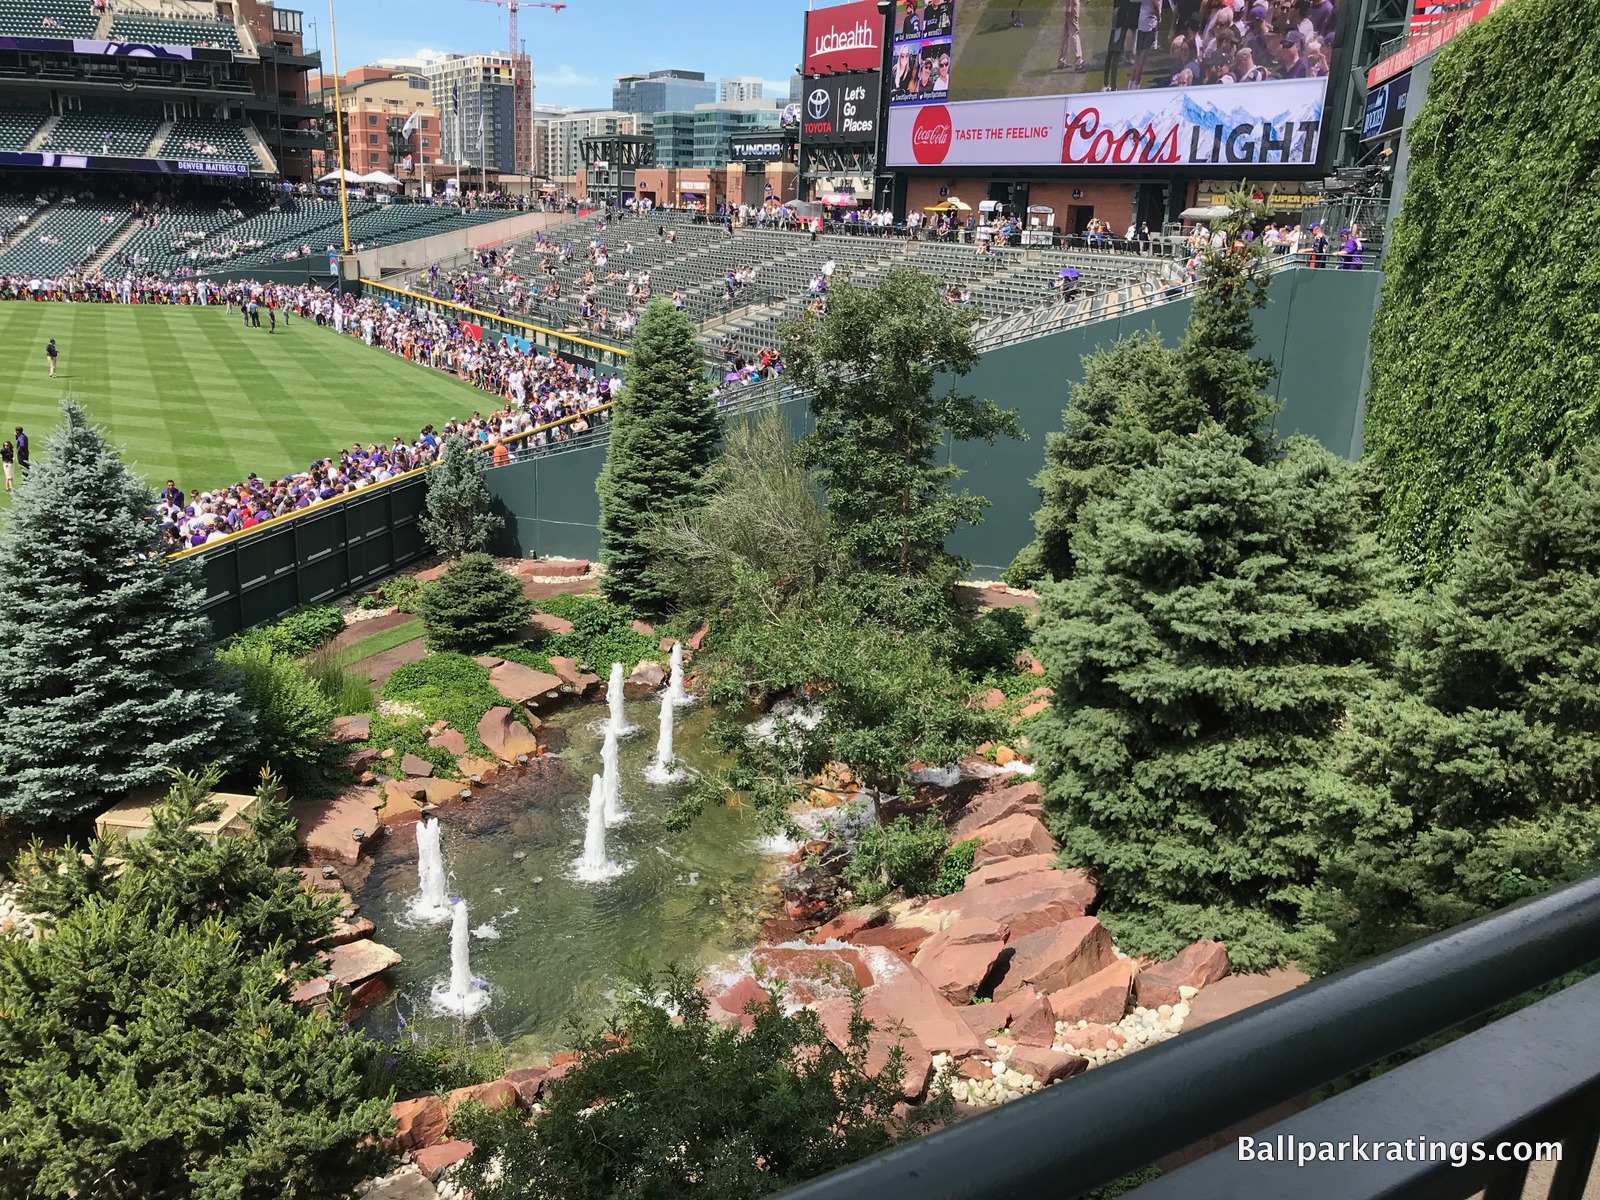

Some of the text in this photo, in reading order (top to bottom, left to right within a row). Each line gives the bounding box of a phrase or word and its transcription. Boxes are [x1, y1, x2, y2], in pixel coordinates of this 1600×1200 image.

[815, 19, 872, 53] uchealth
[844, 86, 866, 101] Let's
[843, 102, 856, 116] Go
[804, 122, 832, 133] TOYOTA
[843, 118, 873, 132] Places
[955, 129, 983, 140] TASTE
[985, 128, 1003, 139] THE
[1061, 107, 1320, 164] Coors LIGHT
[734, 143, 780, 156] TUNDRA
[178, 161, 203, 170] DENVER
[205, 163, 236, 172] MATTRESS
